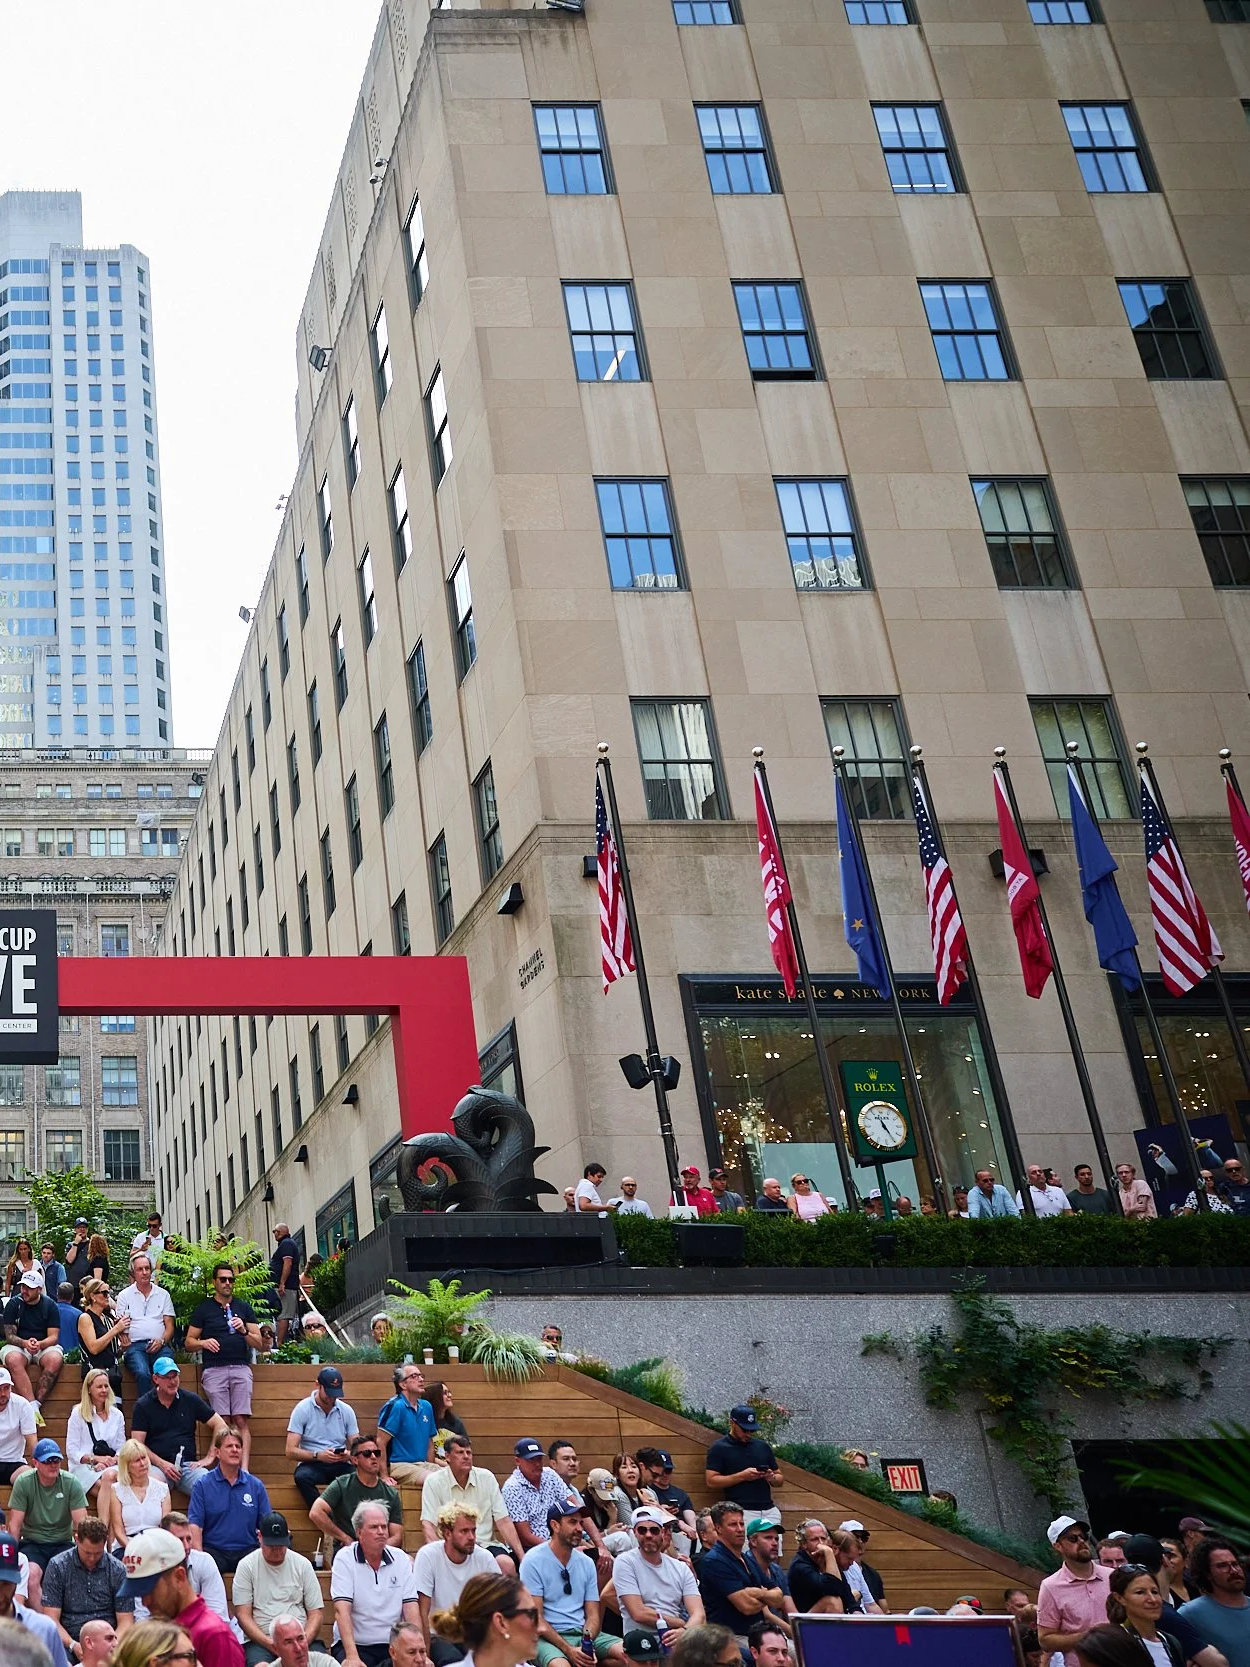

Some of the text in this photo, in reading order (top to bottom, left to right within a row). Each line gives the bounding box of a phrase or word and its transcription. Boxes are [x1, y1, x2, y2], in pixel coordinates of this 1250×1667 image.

[518, 947, 543, 978] CHANNEL
[520, 960, 545, 990] GARDENS
[735, 985, 772, 999] kate
[851, 988, 882, 998] NEW
[899, 988, 930, 998] ORK
[854, 1083, 897, 1092] ROLEX
[888, 1467, 920, 1489] EXIT
[123, 1555, 142, 1566] DER
